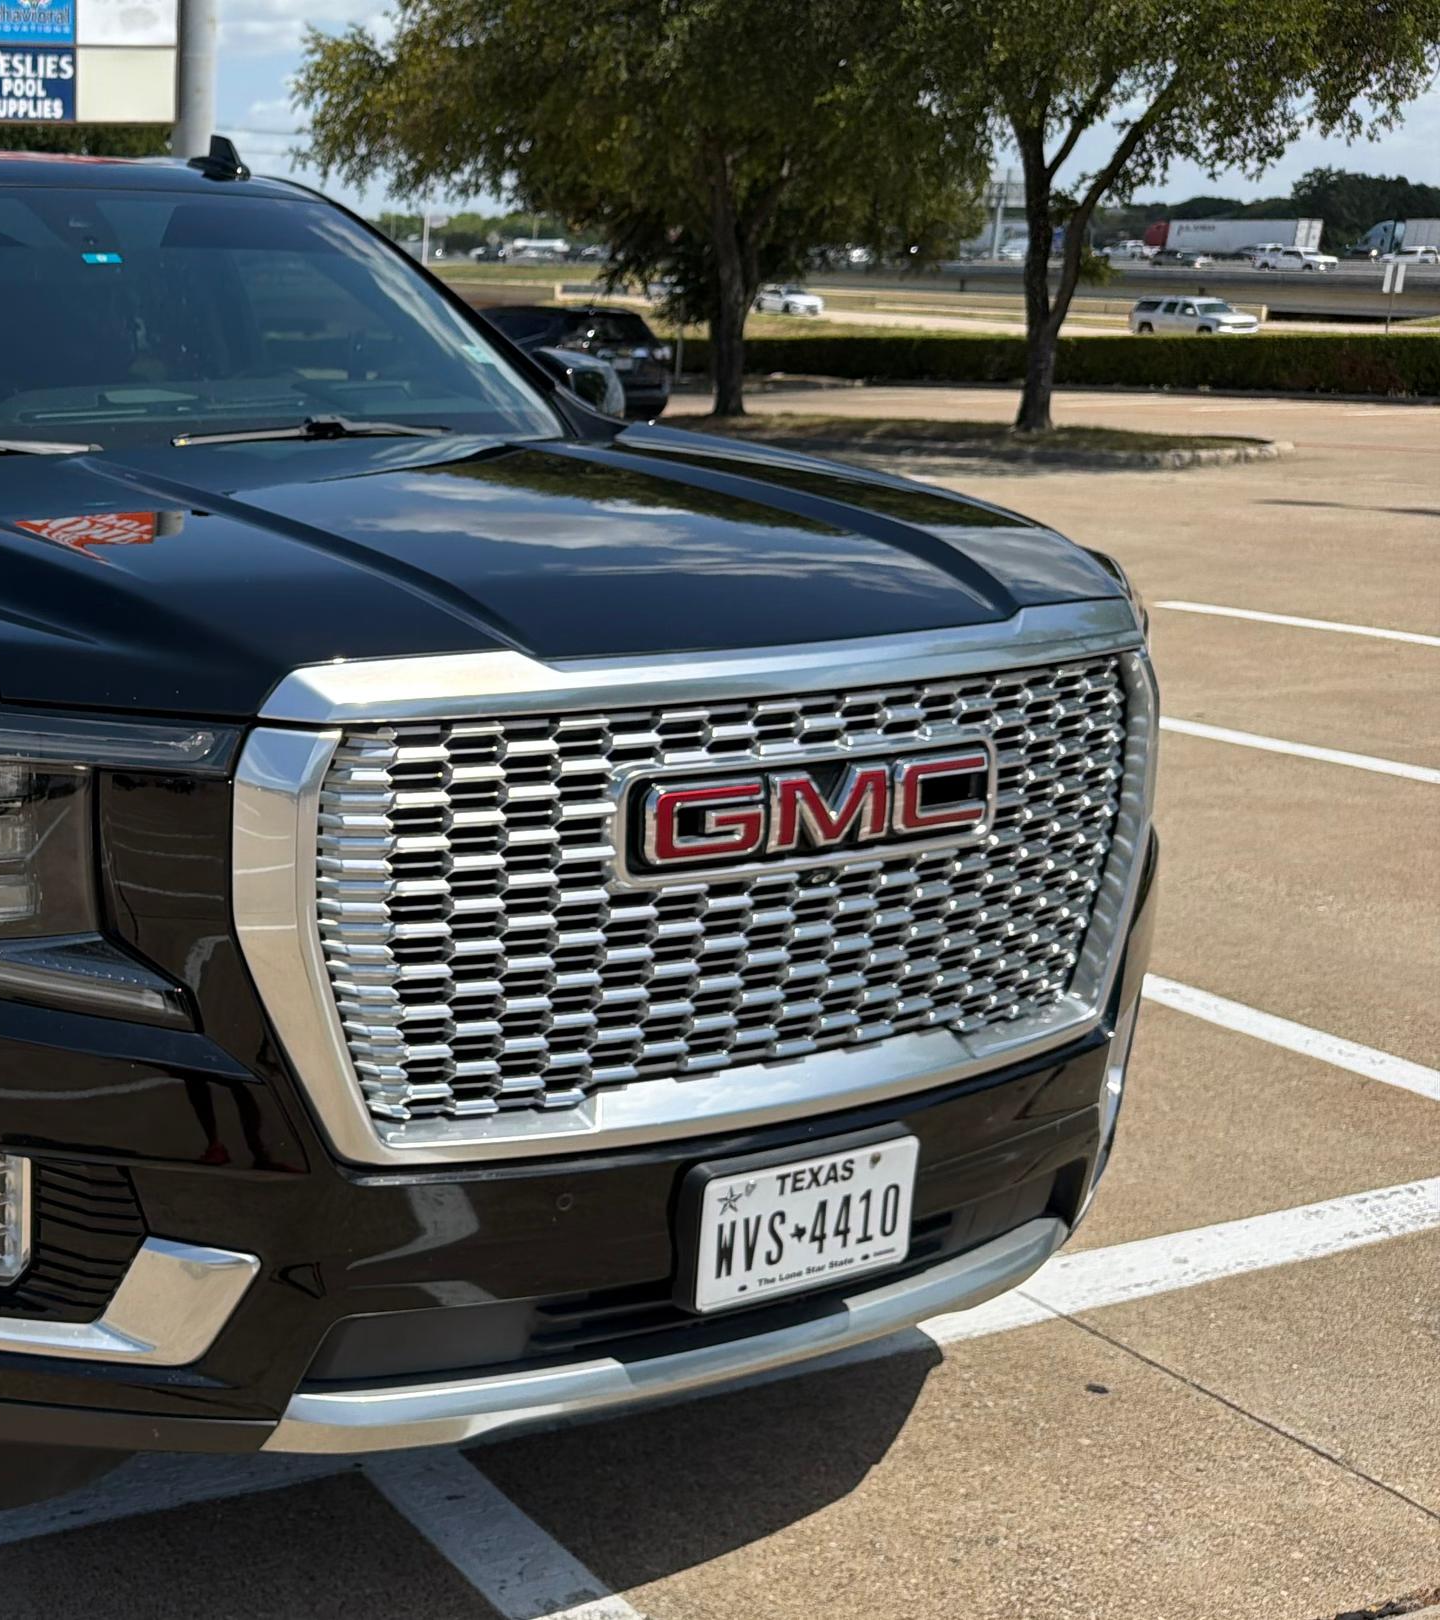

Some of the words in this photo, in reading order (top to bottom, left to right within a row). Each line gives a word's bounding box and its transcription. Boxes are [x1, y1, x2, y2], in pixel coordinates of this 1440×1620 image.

[2, 79, 47, 97] POOL
[643, 749, 989, 864] GMC
[776, 1158, 855, 1196] TEXAS
[757, 1276, 776, 1287] The
[778, 1269, 803, 1282] Lone
[805, 1264, 826, 1275] Star
[828, 1256, 855, 1269] State
